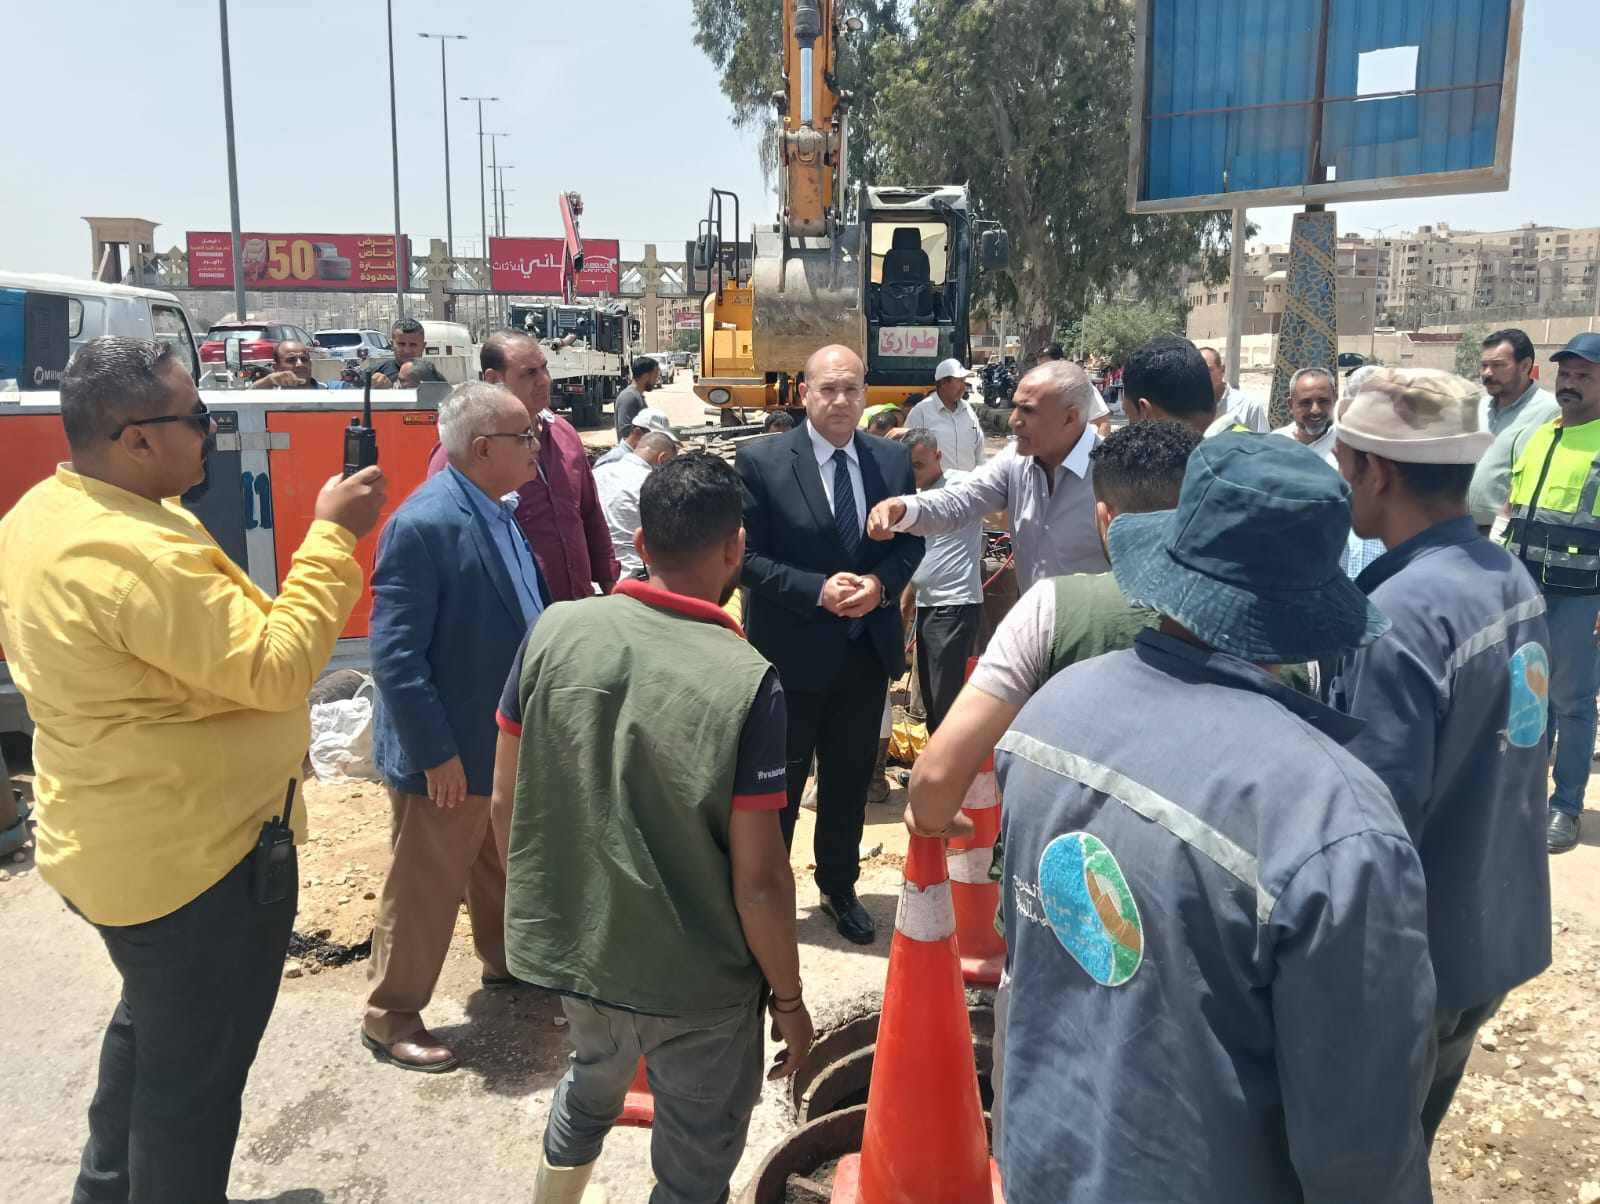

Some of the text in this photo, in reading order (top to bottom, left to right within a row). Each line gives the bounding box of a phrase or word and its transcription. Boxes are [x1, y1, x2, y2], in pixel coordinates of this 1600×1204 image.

[357, 238, 393, 248] عرض
[358, 248, 394, 259] خاص
[267, 239, 313, 281] 50
[360, 272, 396, 282] محدودة
